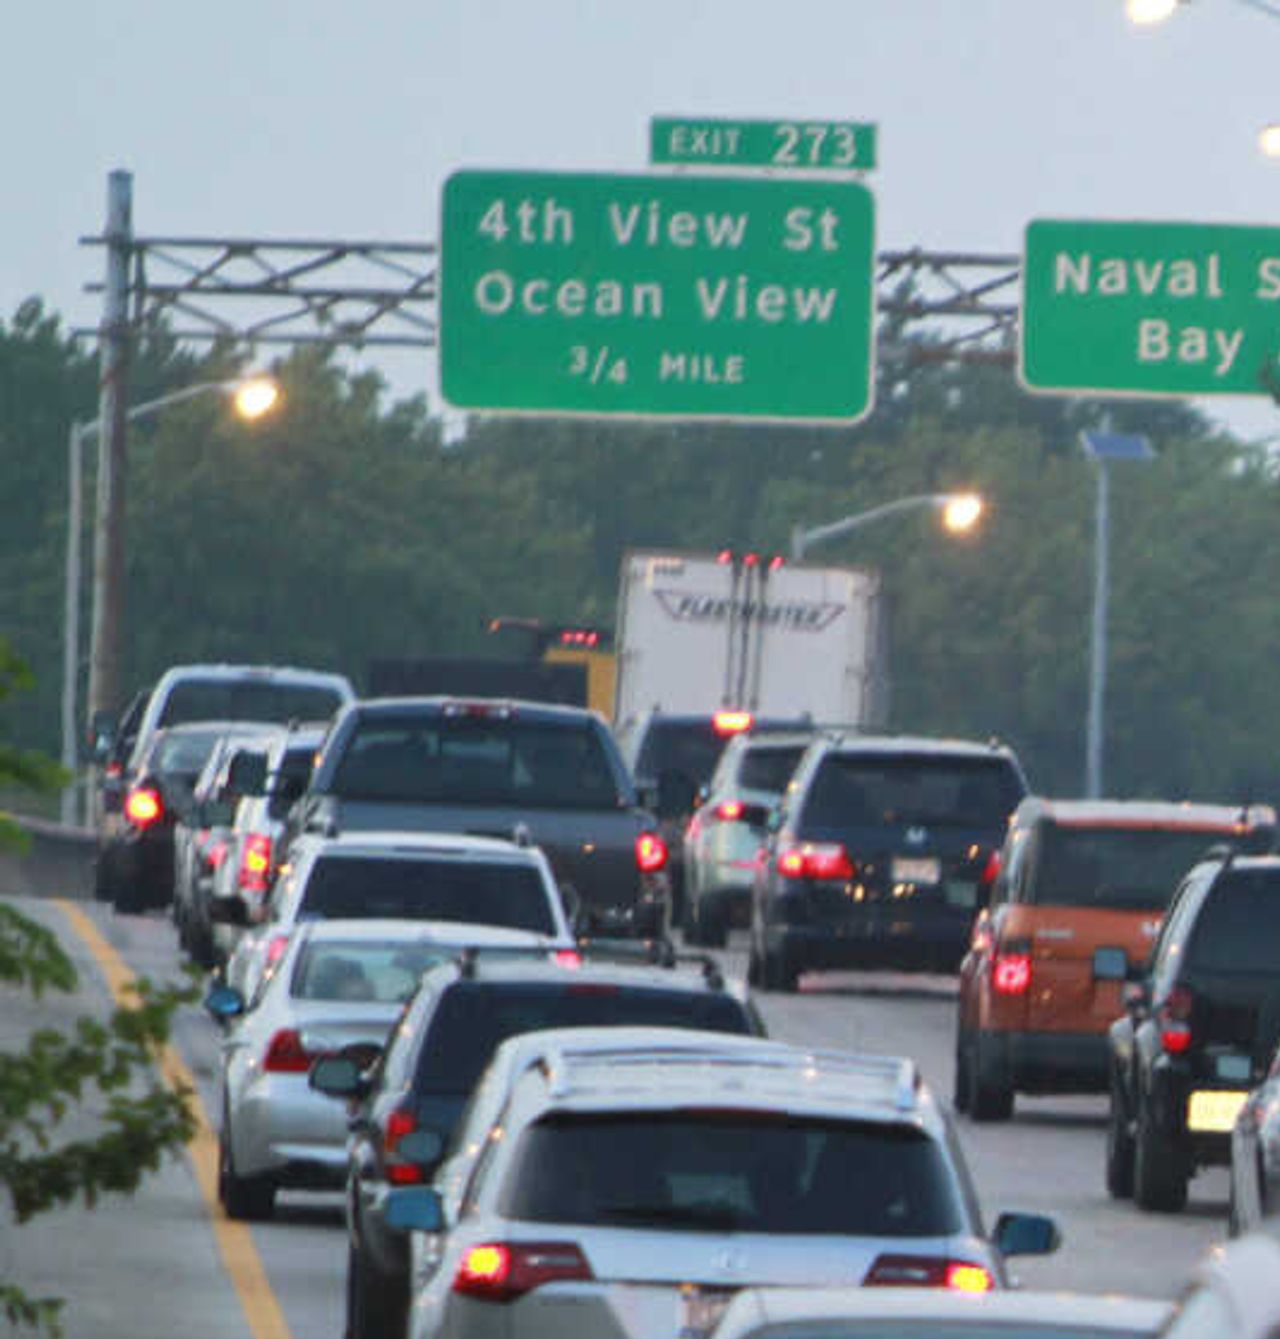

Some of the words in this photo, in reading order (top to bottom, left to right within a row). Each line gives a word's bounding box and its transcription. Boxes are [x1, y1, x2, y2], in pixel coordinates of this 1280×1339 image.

[668, 127, 742, 156] EXIT
[773, 122, 857, 166] 273
[477, 199, 574, 245] 4th
[608, 200, 748, 248] View
[782, 207, 840, 251] St
[474, 270, 664, 318] Ocean
[696, 276, 838, 322] View
[1055, 252, 1224, 297] Naval
[568, 345, 628, 386] 3/4
[659, 354, 745, 384] MILE
[1138, 319, 1244, 376] Bay
